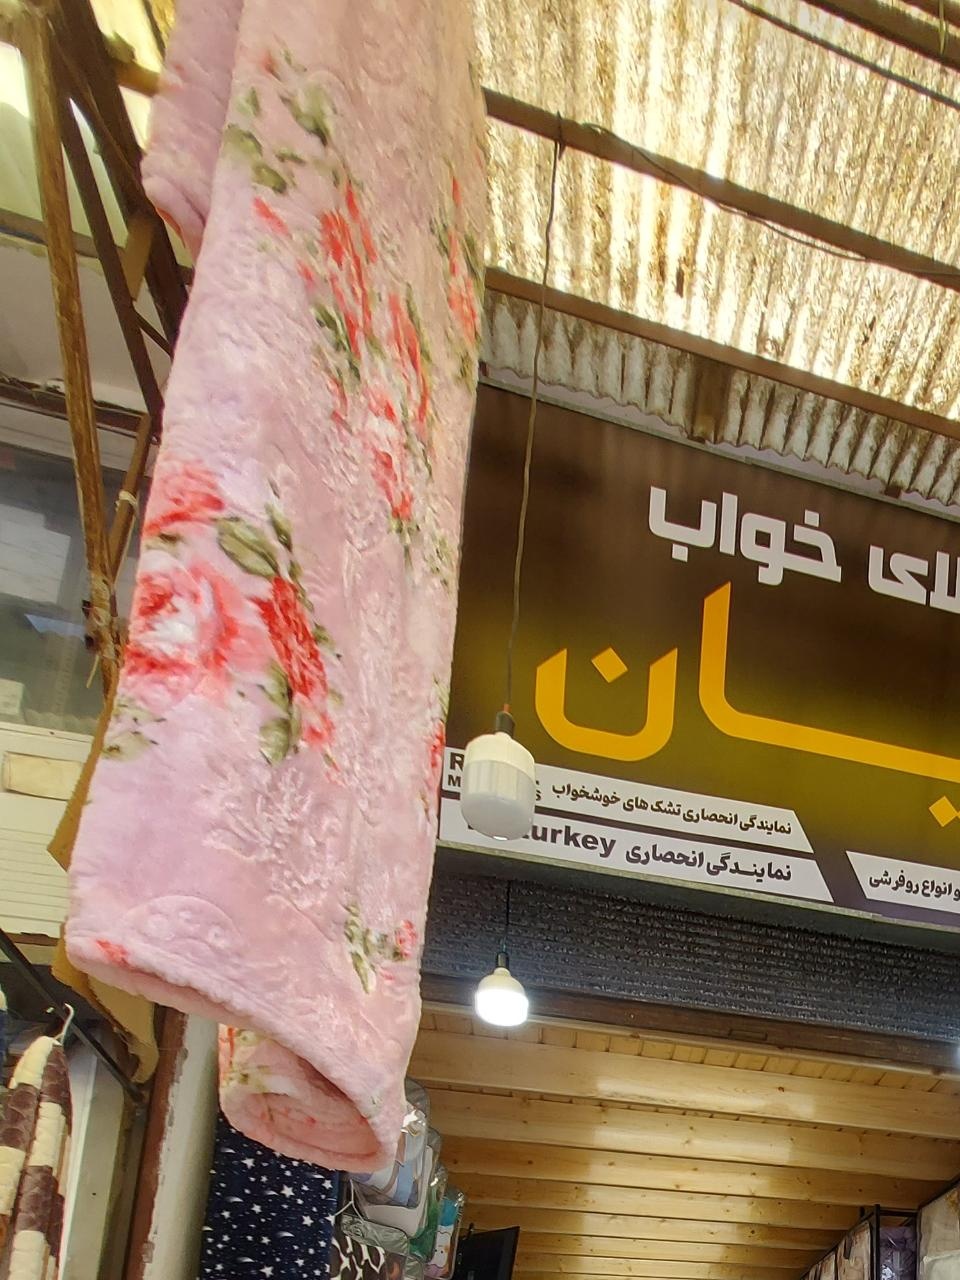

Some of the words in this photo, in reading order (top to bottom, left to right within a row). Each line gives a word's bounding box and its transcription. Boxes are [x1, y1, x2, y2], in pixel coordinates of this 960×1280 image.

[648, 485, 842, 586] خواب
[552, 783, 621, 807] خوشخواب
[622, 796, 649, 812] های
[650, 800, 681, 816] تشک
[682, 808, 738, 825] انحصاری
[739, 814, 792, 835] نمایندگی
[522, 824, 617, 858] urkey
[625, 844, 705, 868] انحصاری
[706, 851, 792, 883] نمایندگی
[921, 879, 953, 898] انواع
